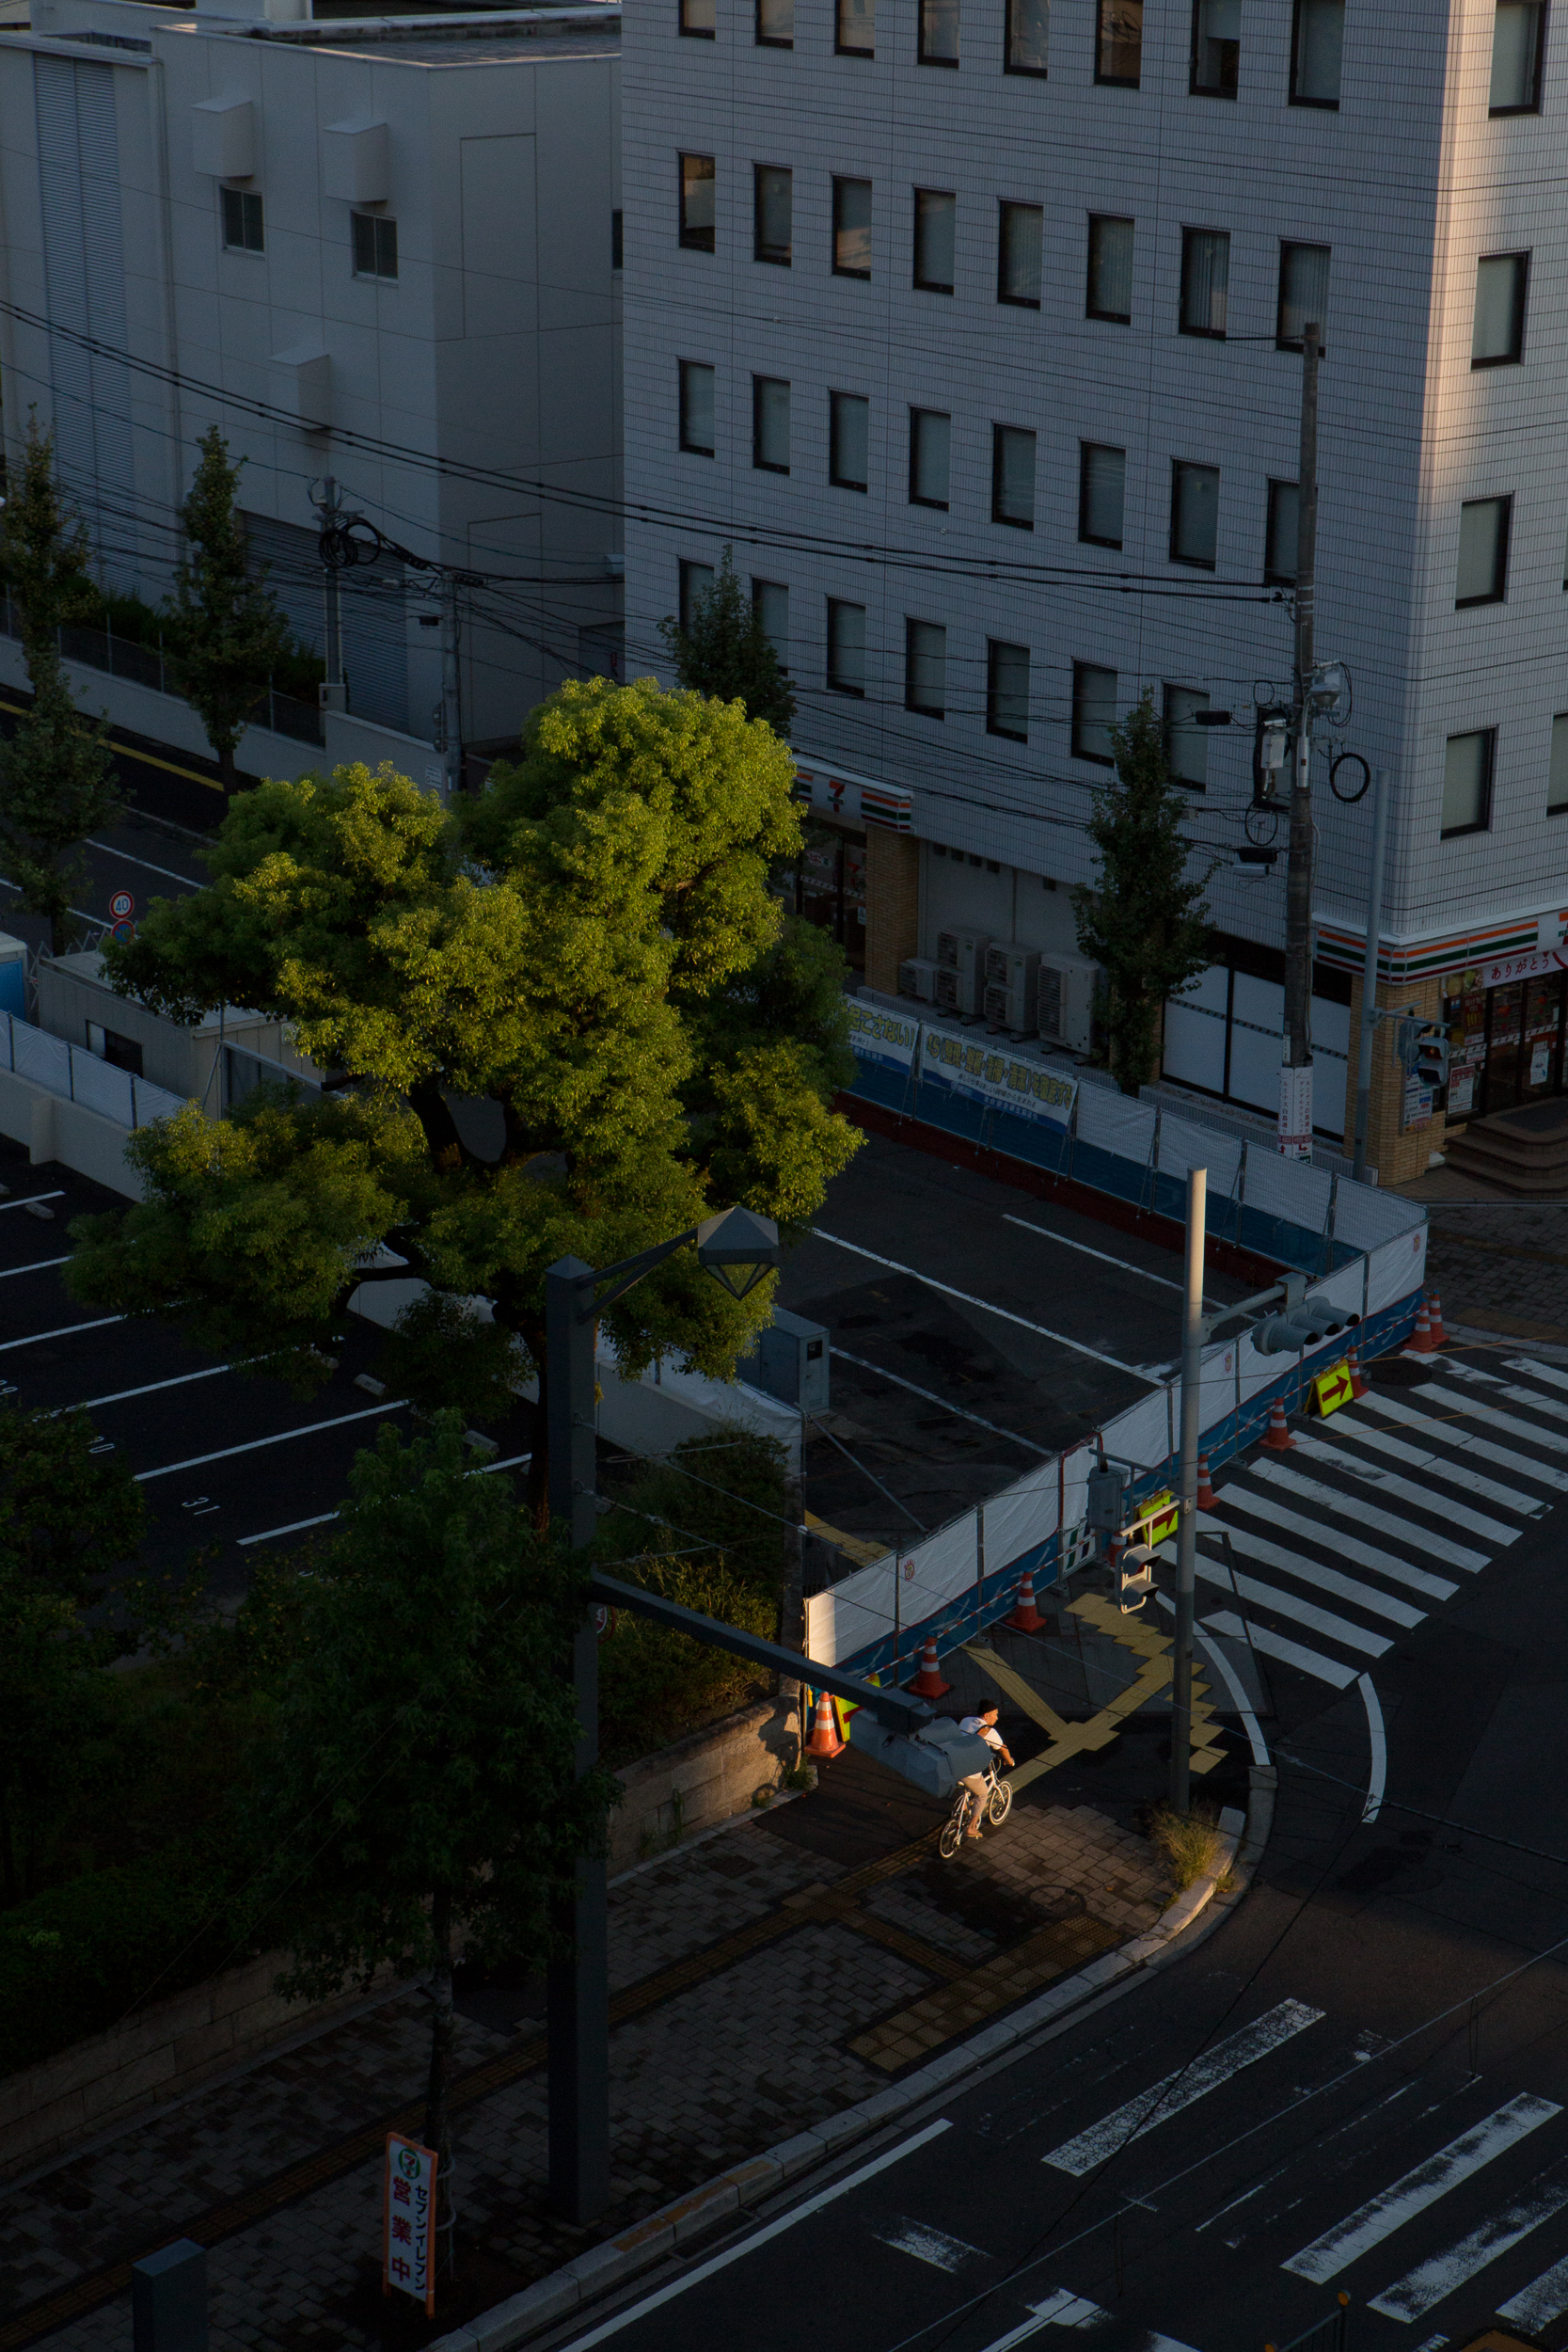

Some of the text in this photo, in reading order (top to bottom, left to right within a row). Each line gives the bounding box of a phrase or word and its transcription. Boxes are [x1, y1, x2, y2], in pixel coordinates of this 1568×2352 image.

[116, 898, 129, 911] 40
[1491, 951, 1549, 980] ありがとう
[181, 1496, 221, 1516] 31
[391, 2175, 412, 2282] 営業中
[415, 2185, 428, 2292] セブンイレブン
